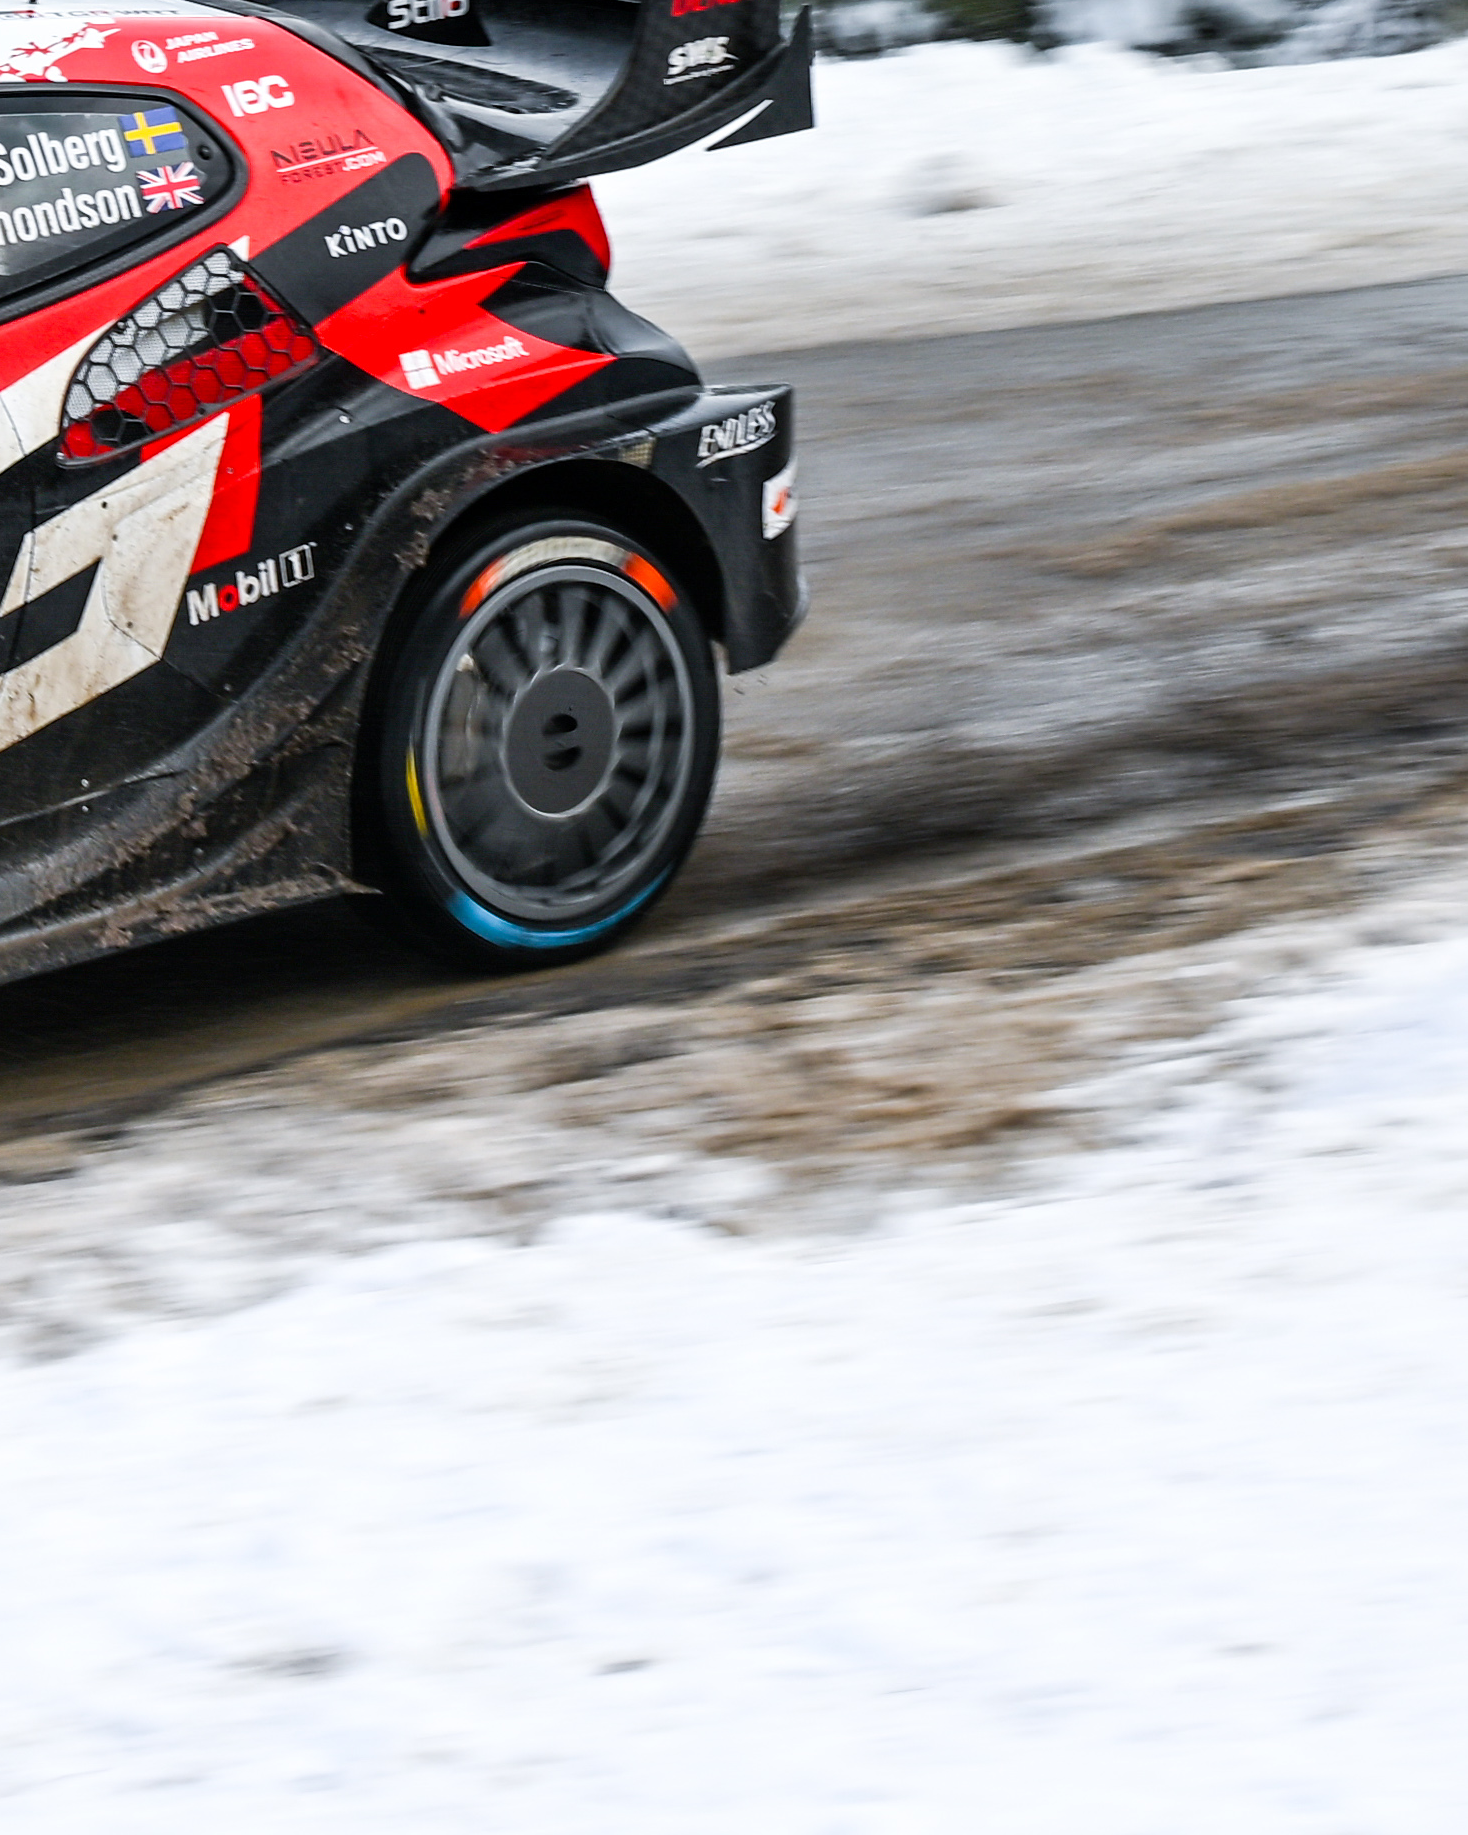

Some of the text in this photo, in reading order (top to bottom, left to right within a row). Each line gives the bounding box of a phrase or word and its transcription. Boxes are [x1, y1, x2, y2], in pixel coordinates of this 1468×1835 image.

[164, 31, 220, 51] JAPAN
[176, 38, 256, 64] AIRLINES
[432, 335, 531, 376] Microsoft
[186, 557, 280, 627] Mobil
